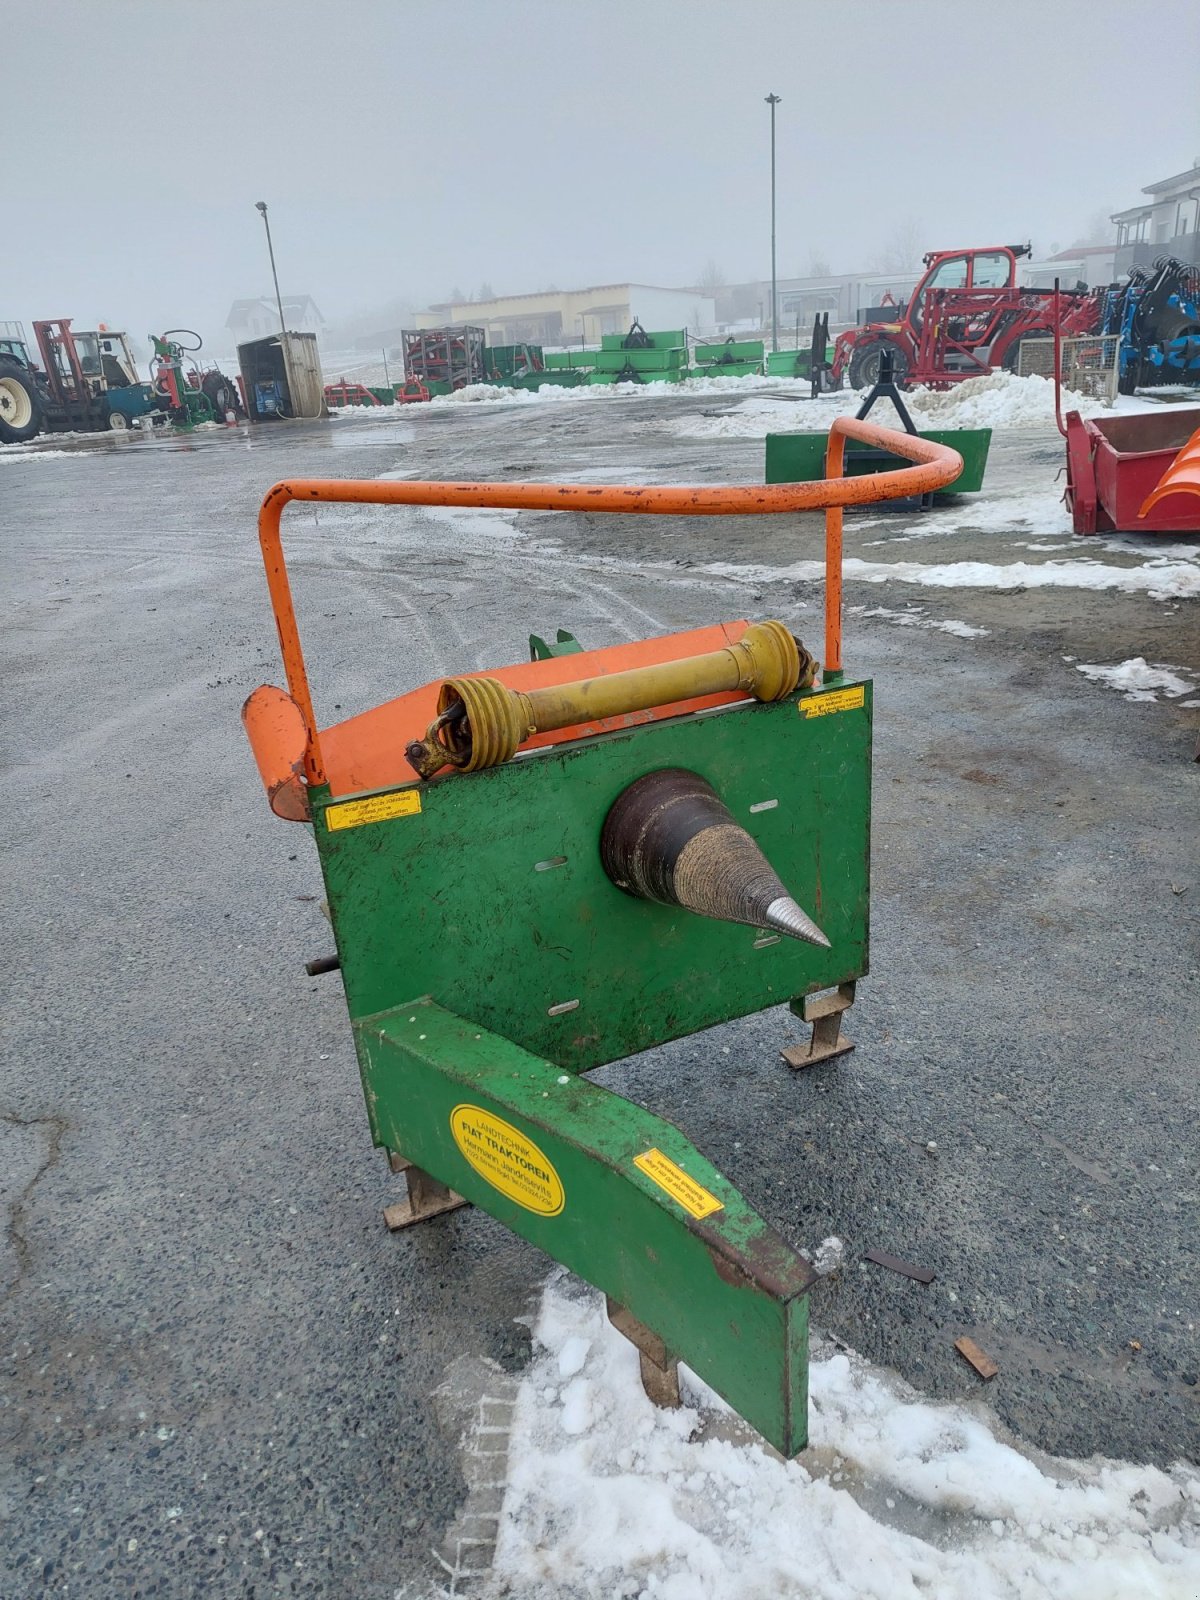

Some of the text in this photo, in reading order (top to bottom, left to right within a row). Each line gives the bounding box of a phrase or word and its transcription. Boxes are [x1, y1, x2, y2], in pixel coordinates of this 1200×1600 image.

[461, 1121, 551, 1183] FIAT TRAKTOREN
[463, 1136, 499, 1164] Hermann
[475, 1119, 531, 1159] LANDTECHNIK
